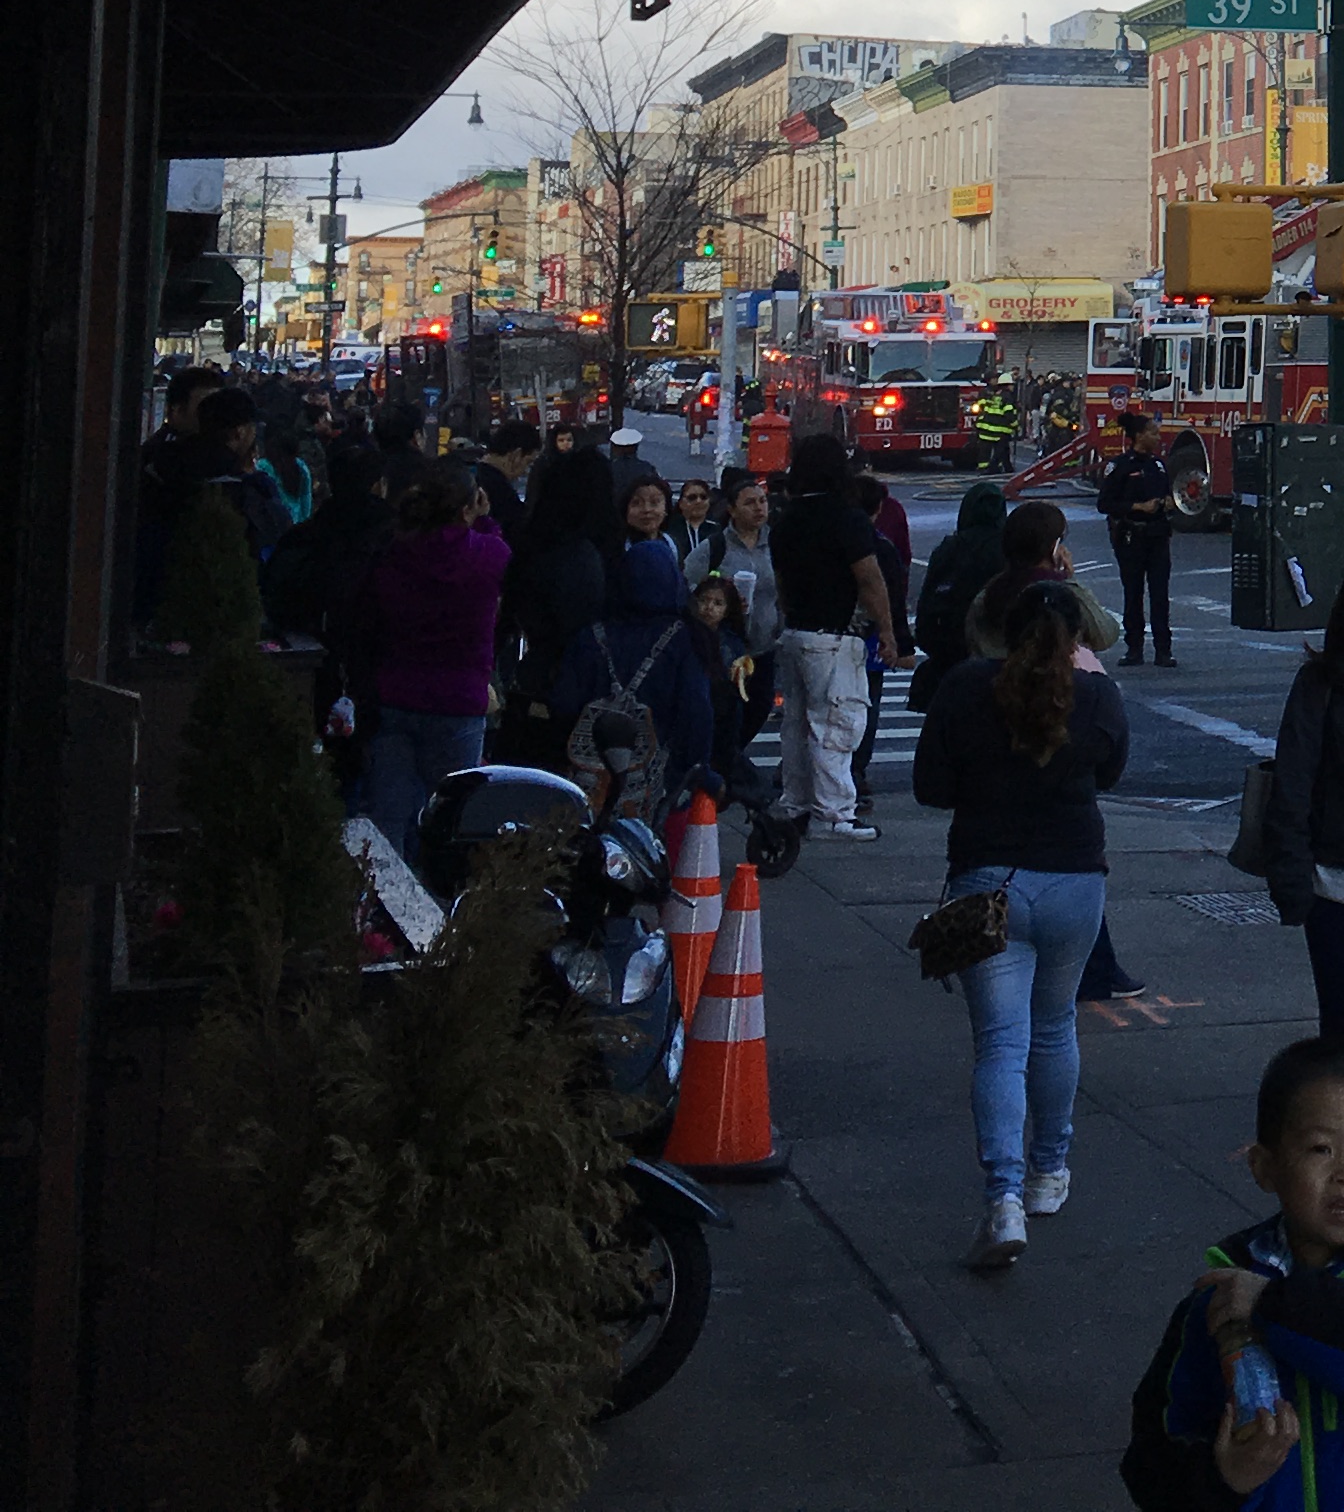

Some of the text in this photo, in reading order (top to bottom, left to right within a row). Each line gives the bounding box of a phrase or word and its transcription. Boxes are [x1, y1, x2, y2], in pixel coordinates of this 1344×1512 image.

[799, 40, 900, 83] CHUPA
[988, 297, 1079, 309] GROCERY
[919, 434, 943, 450] 109
